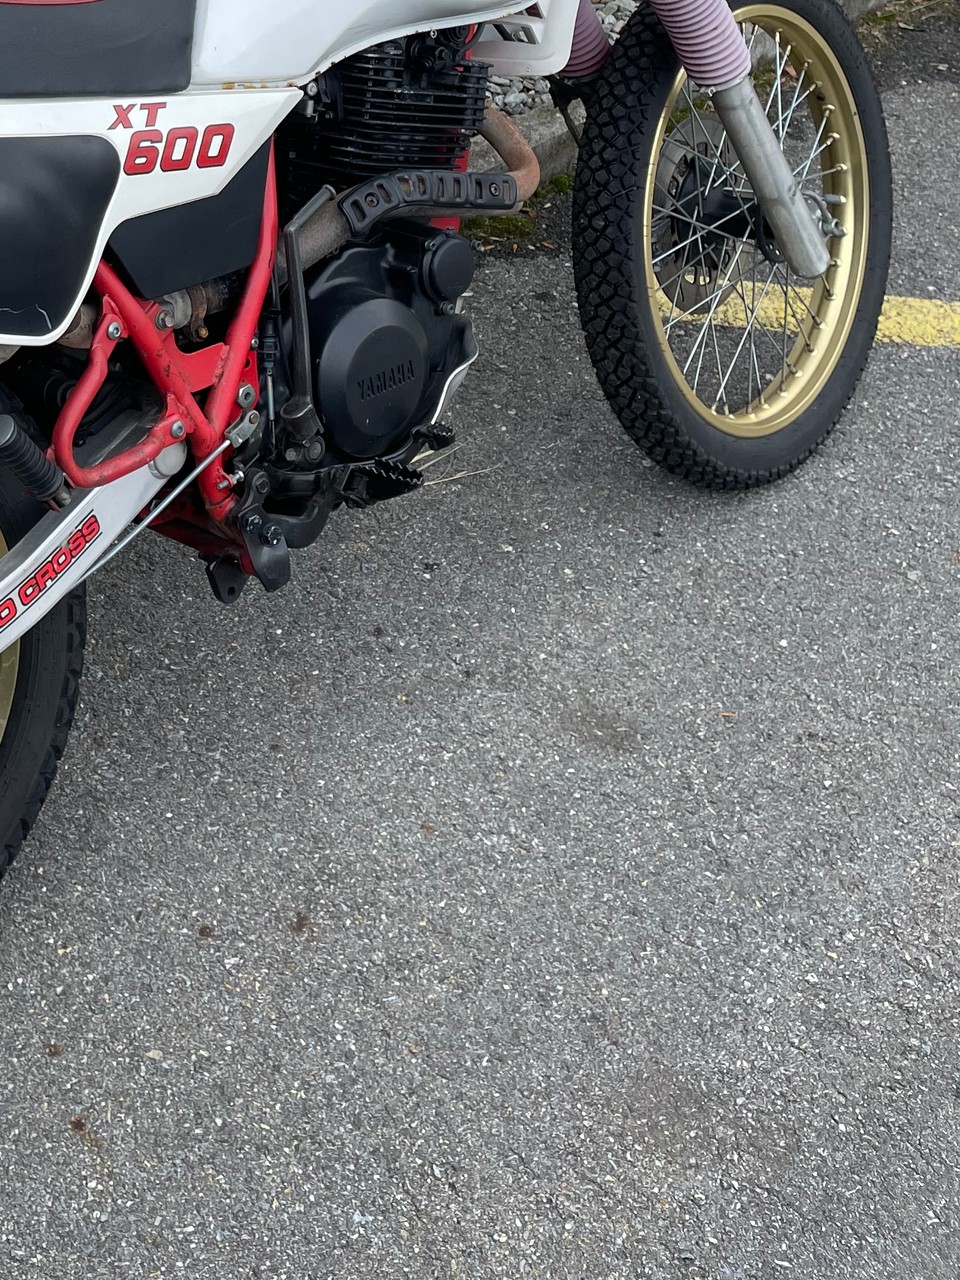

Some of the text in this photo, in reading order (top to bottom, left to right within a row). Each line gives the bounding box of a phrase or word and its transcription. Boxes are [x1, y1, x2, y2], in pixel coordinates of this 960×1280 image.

[107, 102, 167, 130] XT
[123, 123, 235, 176] 600
[357, 360, 414, 401] YAMAHA
[18, 514, 101, 606] CROSS
